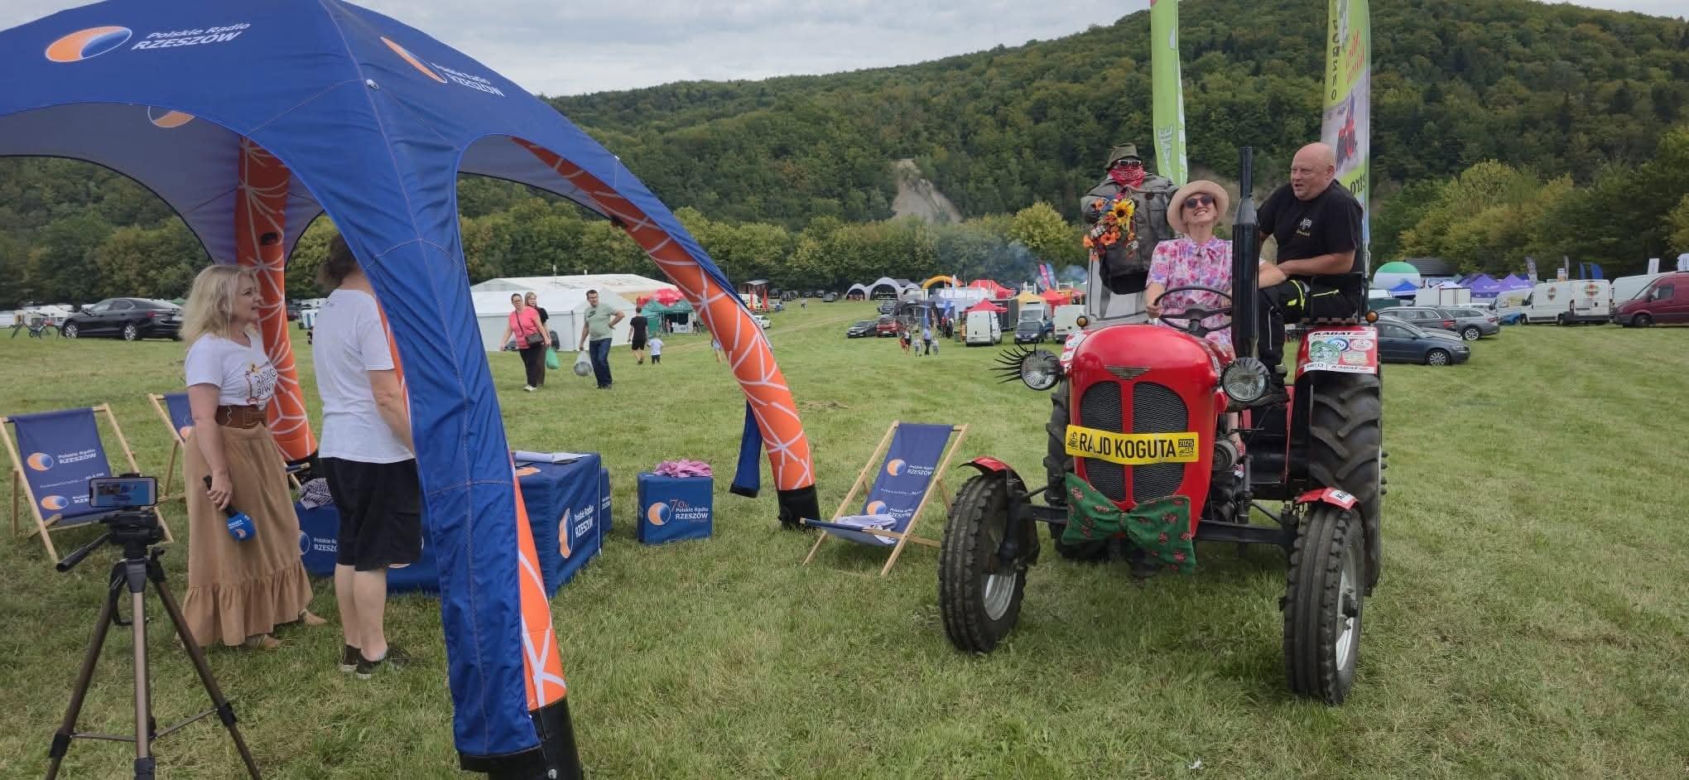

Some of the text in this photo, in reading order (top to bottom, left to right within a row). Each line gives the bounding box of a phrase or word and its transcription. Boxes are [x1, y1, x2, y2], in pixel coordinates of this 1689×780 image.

[146, 22, 251, 39] Polskie Radio
[131, 31, 242, 50] RZESZÓW
[1079, 432, 1177, 459] RAJD KOGUTA
[675, 512, 709, 520] RZESZÓW
